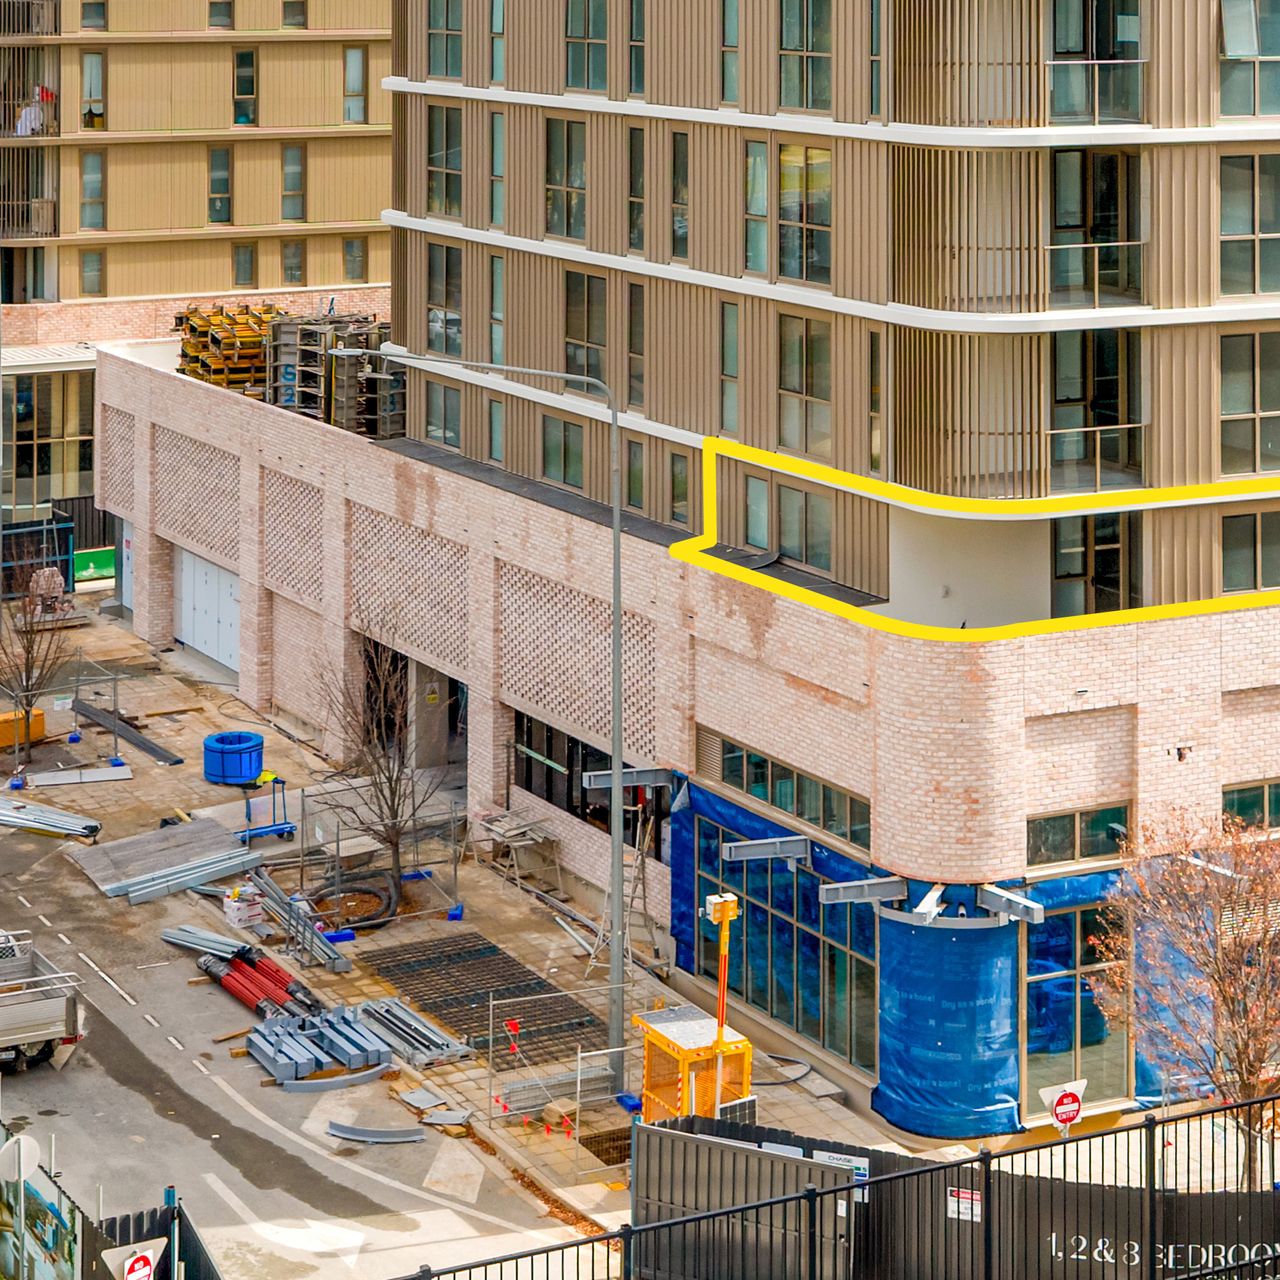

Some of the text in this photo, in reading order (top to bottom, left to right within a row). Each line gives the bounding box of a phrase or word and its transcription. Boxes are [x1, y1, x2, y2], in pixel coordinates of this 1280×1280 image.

[1057, 1111, 1077, 1121] ENTRY
[1070, 1235, 1087, 1260] 2
[1093, 1238, 1115, 1263] &
[1123, 1241, 1140, 1265] 3
[134, 1260, 144, 1271] NO
